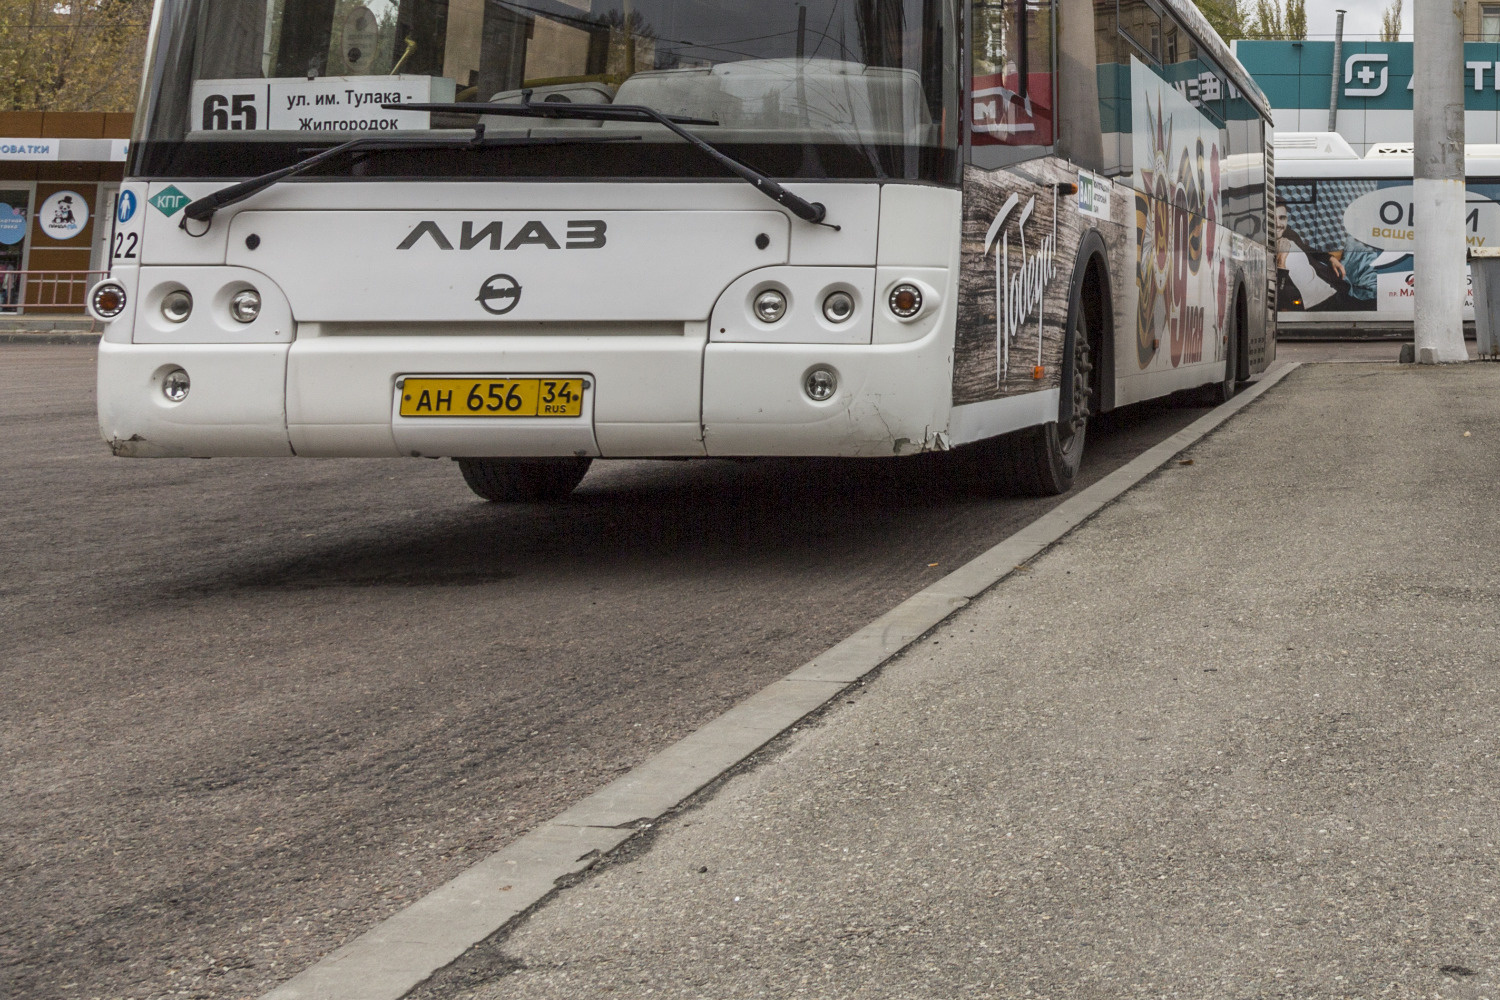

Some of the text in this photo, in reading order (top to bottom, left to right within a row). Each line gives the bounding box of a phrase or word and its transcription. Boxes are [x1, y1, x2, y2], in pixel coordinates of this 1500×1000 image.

[202, 94, 257, 131] 65
[286, 94, 311, 110] ул.
[315, 93, 340, 106] им.
[344, 89, 401, 108] Тулака
[0, 144, 49, 154] ОВАТКИ
[156, 195, 184, 209] КПГ
[396, 219, 608, 250] ЛИАЗ
[1372, 226, 1415, 241] ваше
[113, 231, 139, 259] 22
[415, 381, 572, 412] АН 656 34
[544, 404, 567, 414] RUS
